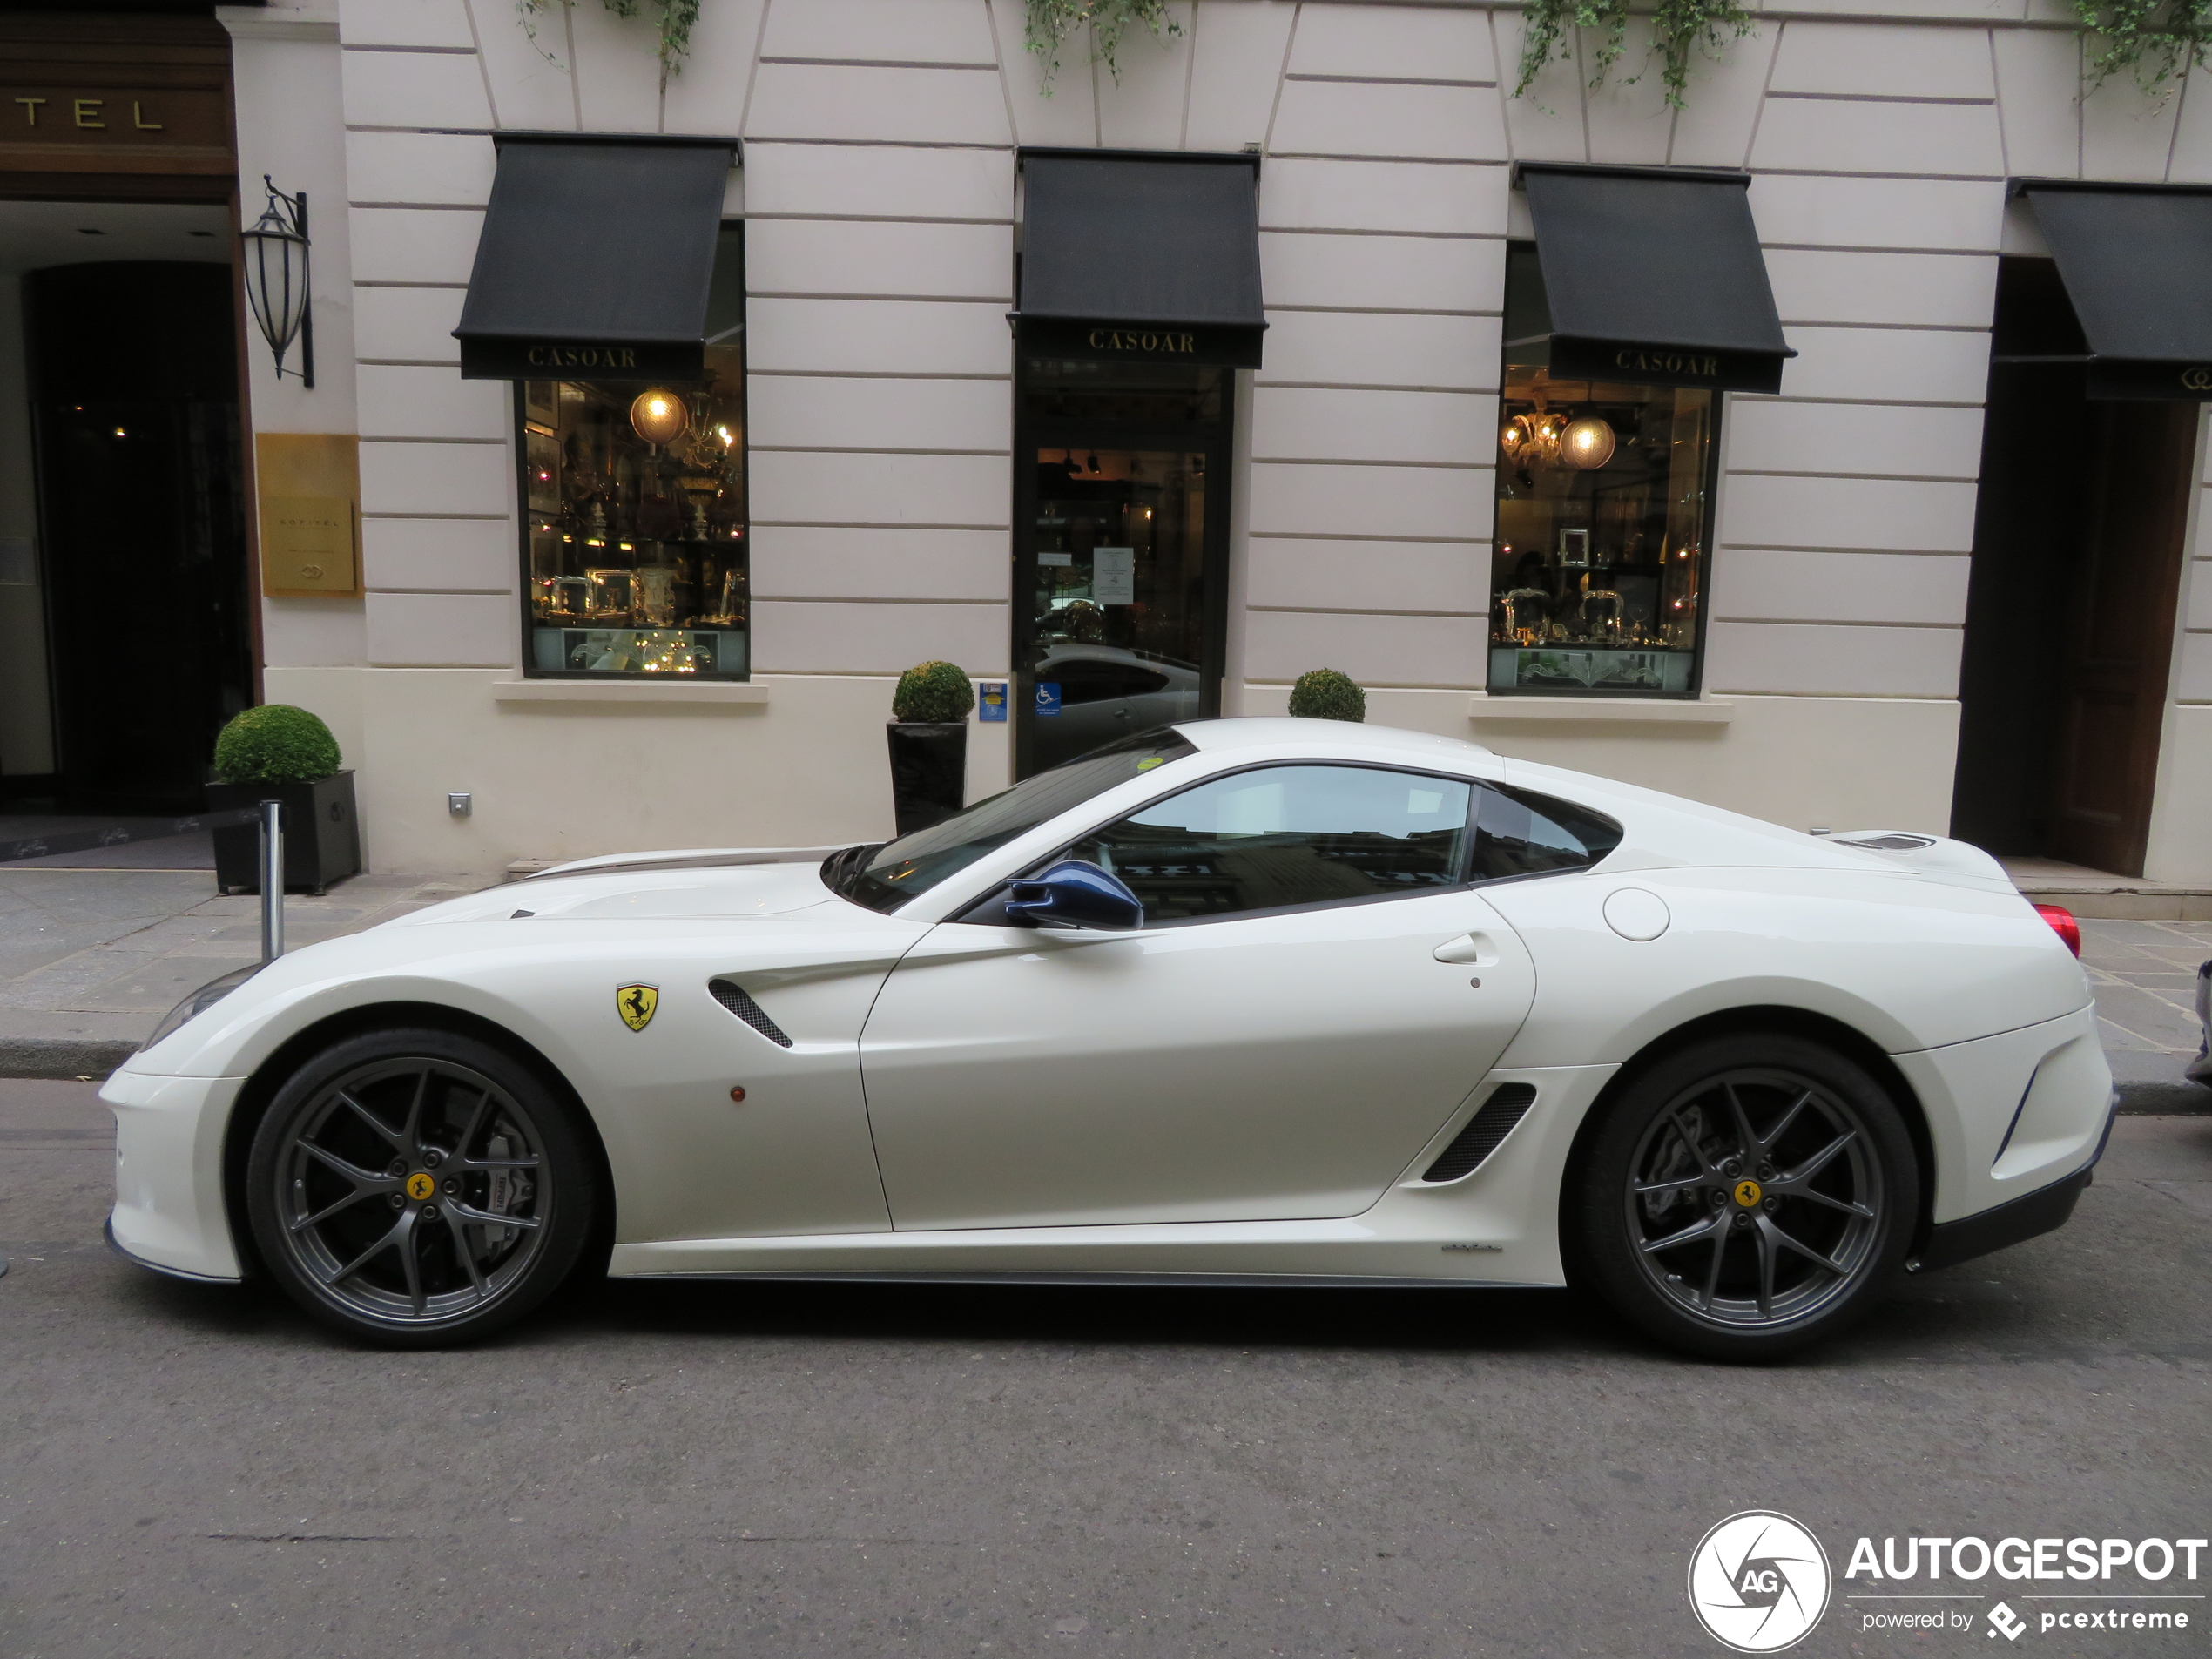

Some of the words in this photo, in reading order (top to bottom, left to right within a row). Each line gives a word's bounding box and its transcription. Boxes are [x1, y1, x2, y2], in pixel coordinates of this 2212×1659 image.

[15, 98, 163, 129] TEL
[1090, 329, 1194, 353] CASOAR
[529, 347, 636, 368] CASOAR
[1616, 351, 1718, 376] CASOAR
